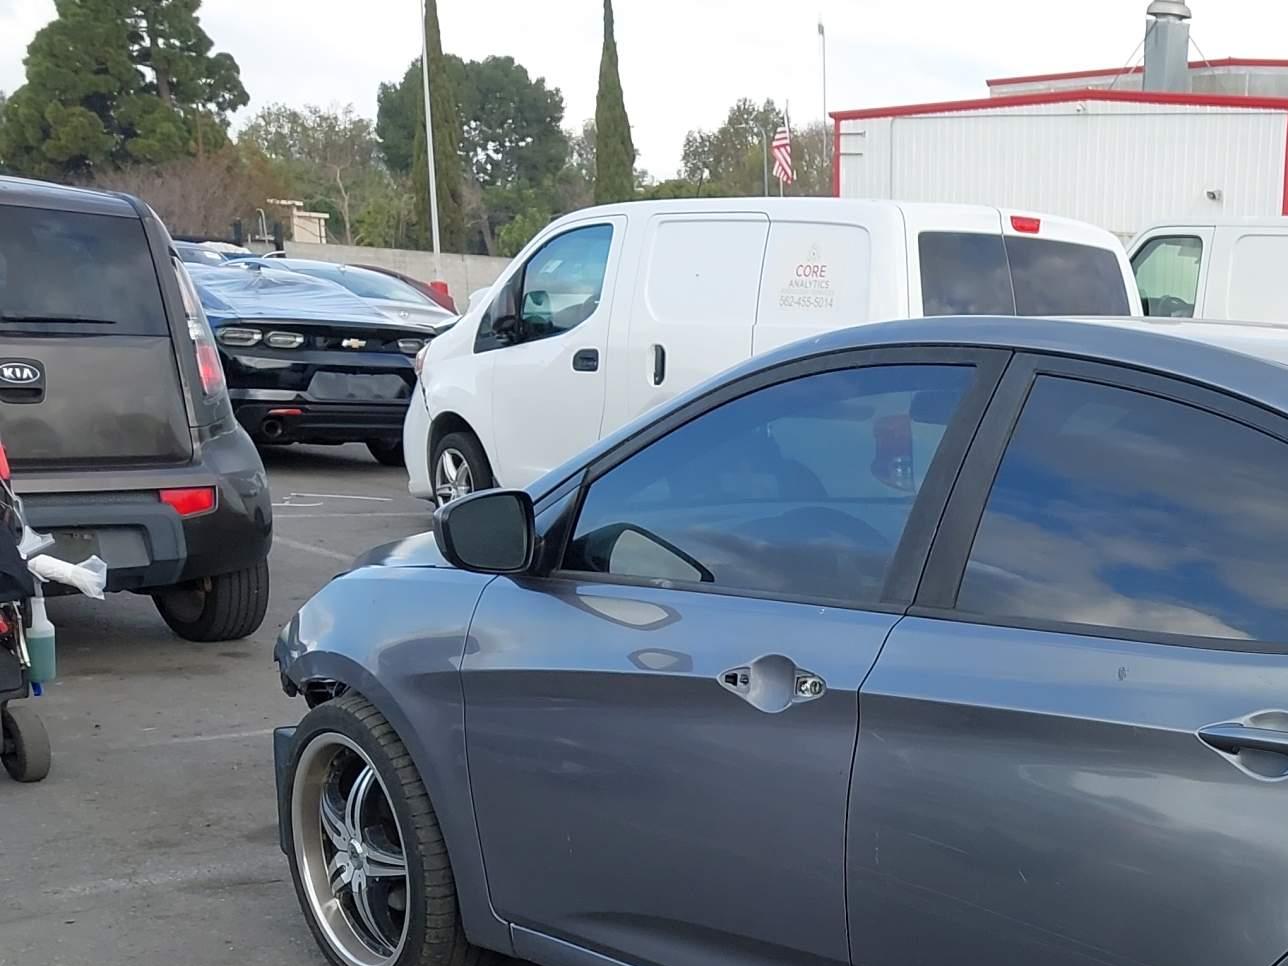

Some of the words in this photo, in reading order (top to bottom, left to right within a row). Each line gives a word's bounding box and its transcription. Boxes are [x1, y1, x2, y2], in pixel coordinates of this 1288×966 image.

[795, 264, 828, 278] CORE
[788, 279, 831, 289] ANALYTICS
[2, 367, 33, 379] KIA
